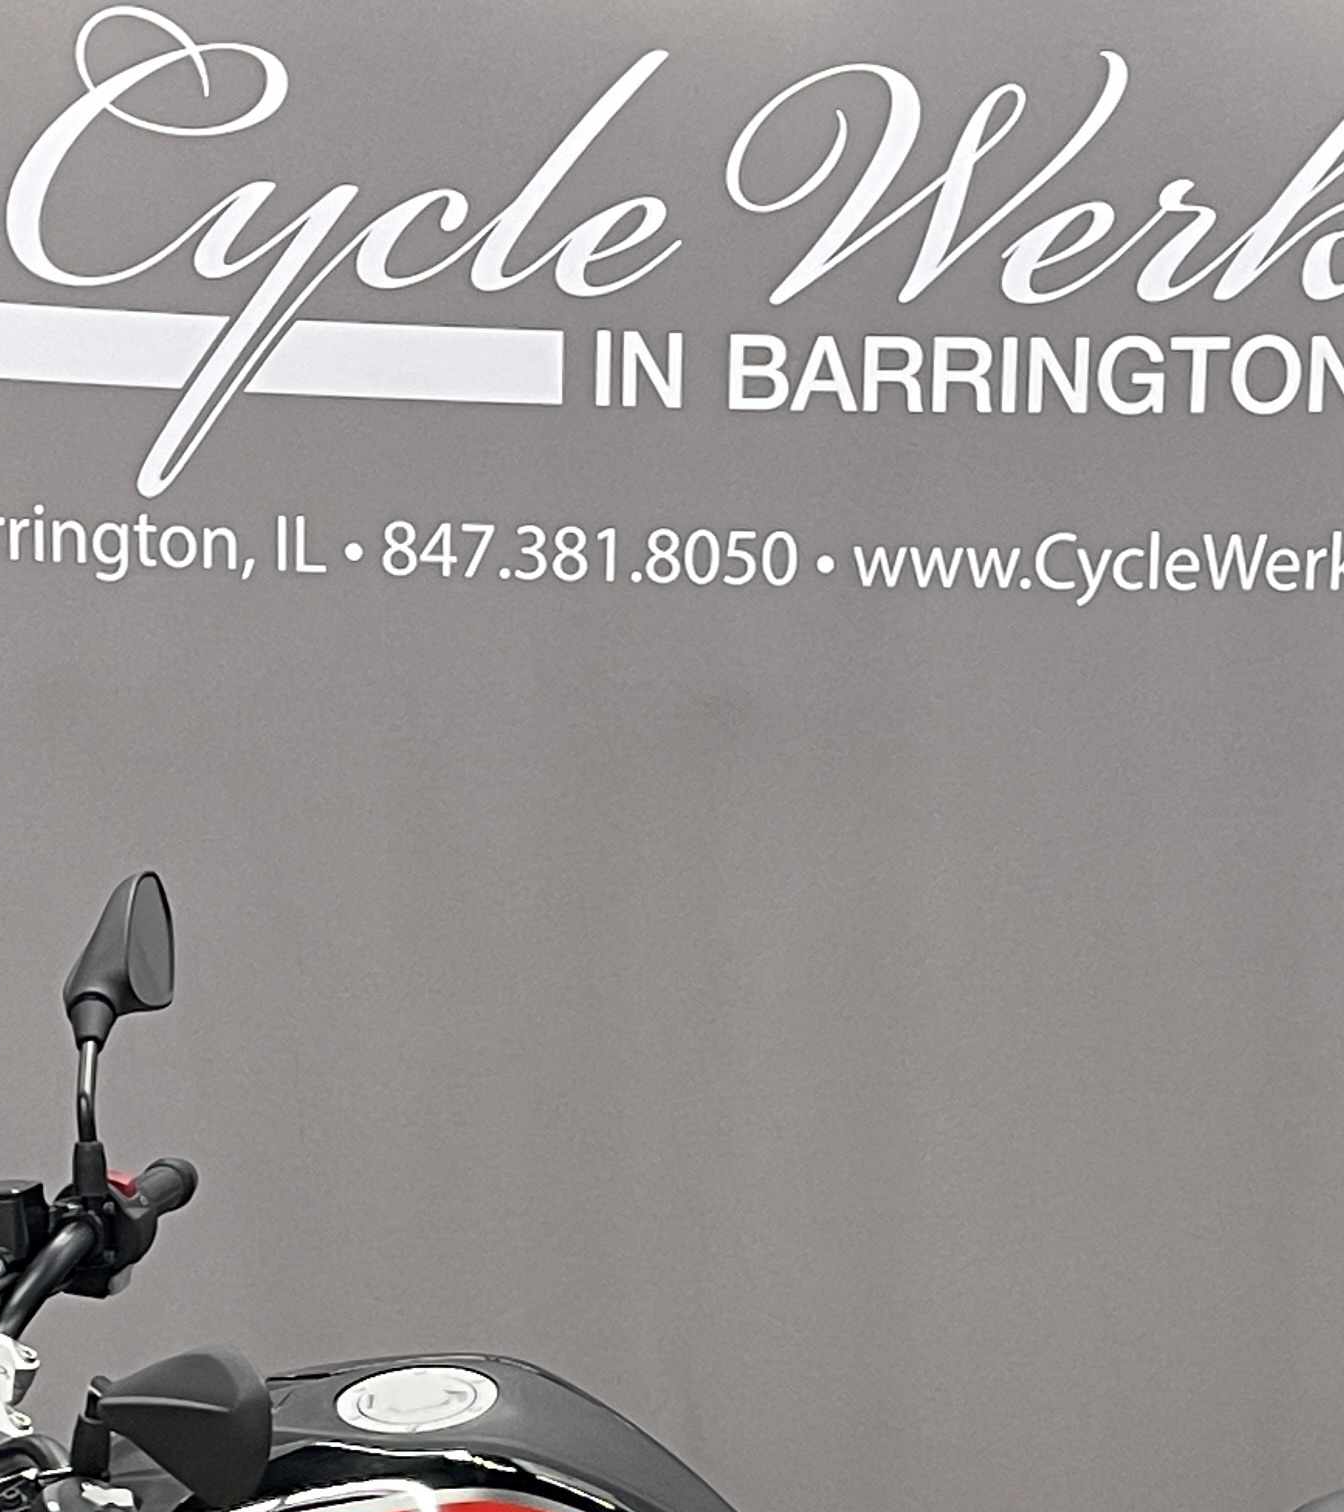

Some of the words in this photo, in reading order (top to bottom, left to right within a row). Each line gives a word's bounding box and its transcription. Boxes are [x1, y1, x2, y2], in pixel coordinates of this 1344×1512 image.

[5, 4, 683, 499] Cycle
[594, 328, 684, 409] IN
[276, 514, 328, 574] IL
[381, 519, 798, 587] 847.381.8050
